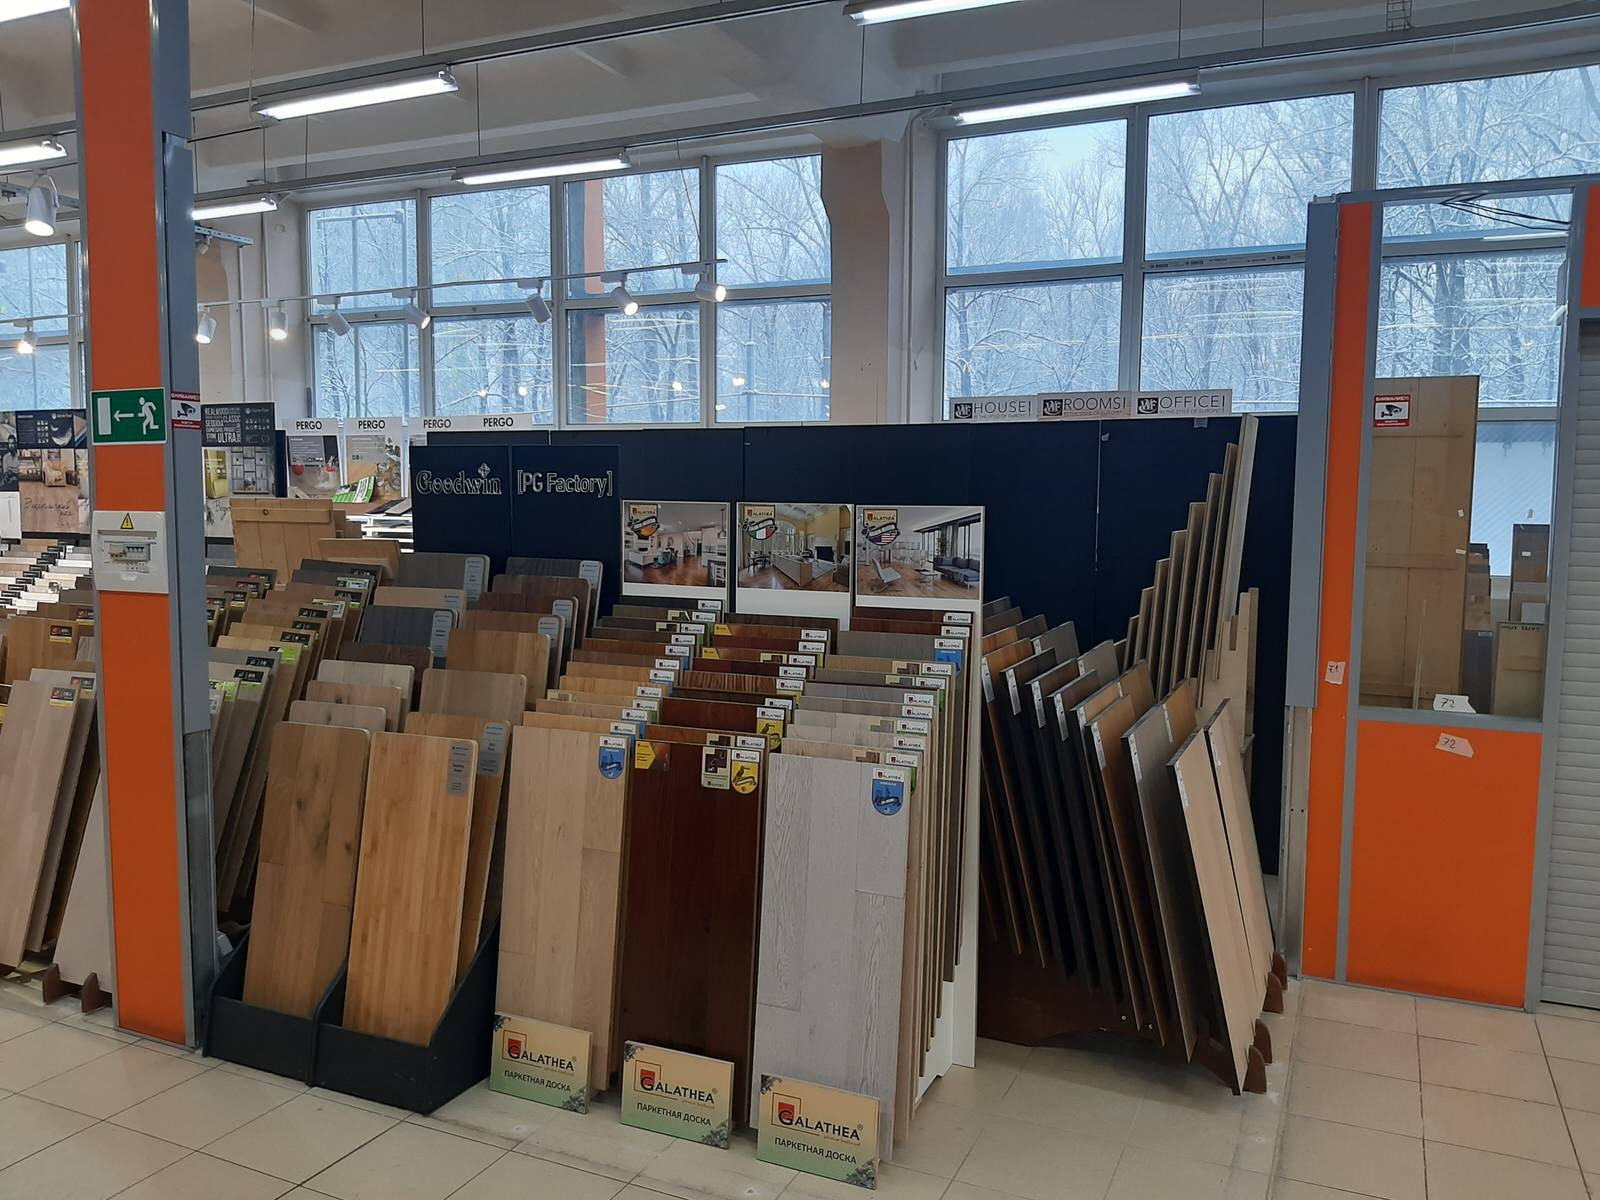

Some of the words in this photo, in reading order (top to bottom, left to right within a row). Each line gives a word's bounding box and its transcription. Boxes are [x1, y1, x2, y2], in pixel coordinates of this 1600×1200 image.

[296, 421, 322, 430] PERGO
[358, 420, 386, 430] PERGO
[423, 419, 451, 428] PERGO
[483, 417, 514, 427] PERGO
[416, 465, 502, 495] Goodwin
[1440, 698, 1455, 708] 72
[1442, 737, 1456, 749] 72
[508, 1045, 574, 1071] GALATHEA
[504, 1070, 545, 1086] ПАРКЕТНАЯ
[545, 1080, 571, 1093] ДОСКА
[641, 1076, 715, 1104] GALATHEA
[637, 1102, 682, 1119] ПАРКЕТНАЯ
[683, 1113, 712, 1126] ДОСКА
[778, 1110, 860, 1140] GALATHEA
[775, 1137, 824, 1157] ПАРКЕТНАЯ
[825, 1150, 857, 1164] ДОСКА
